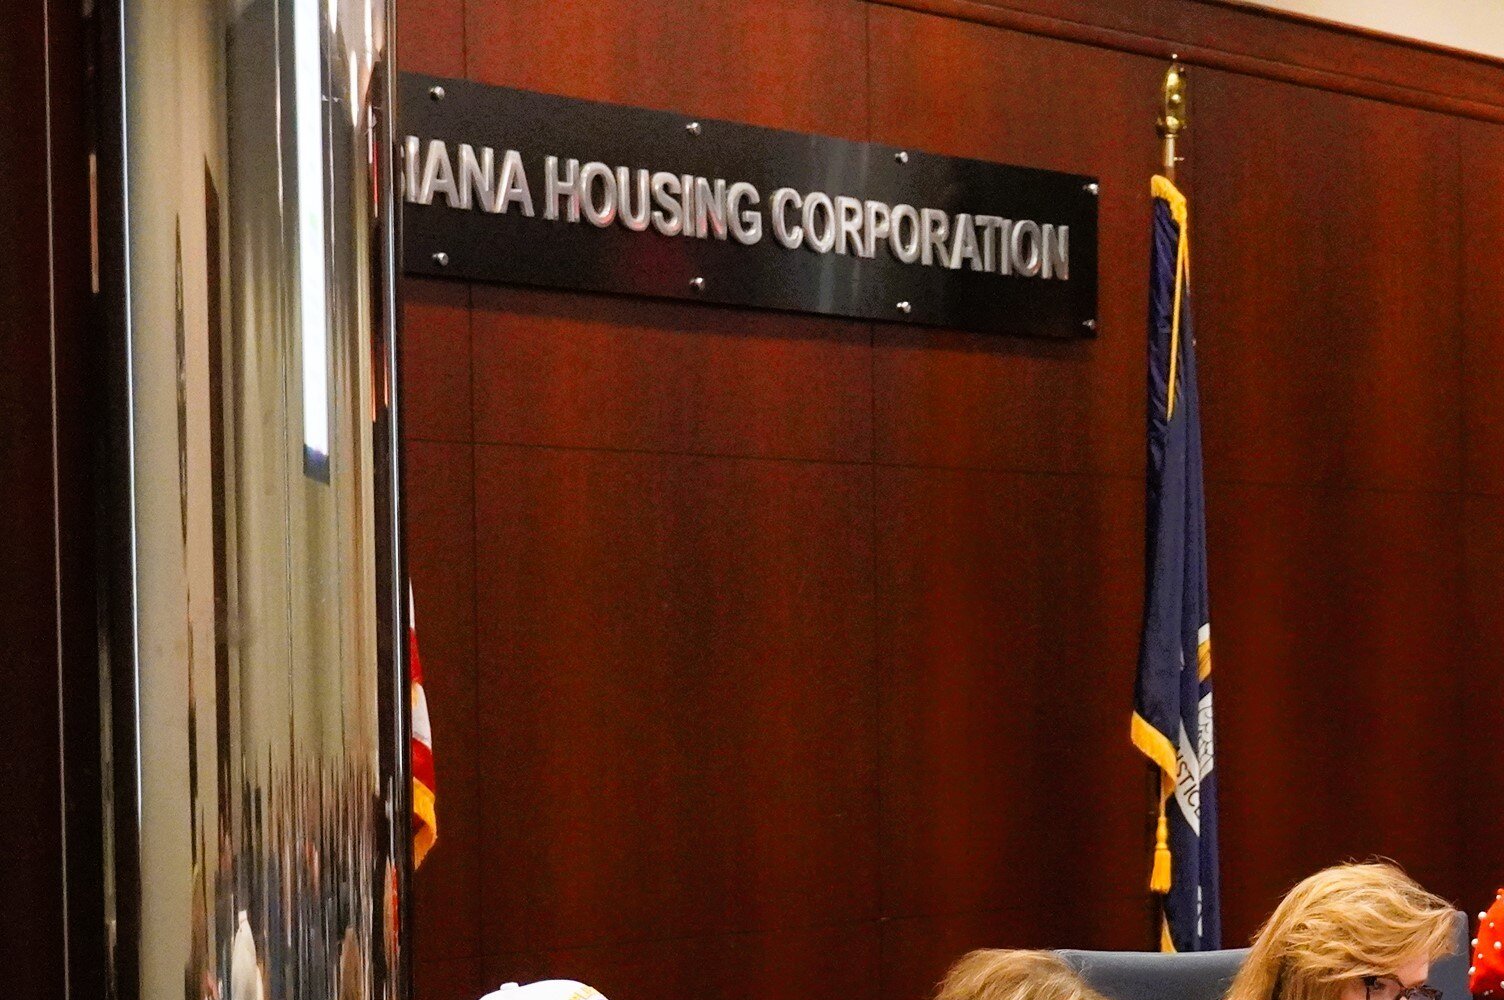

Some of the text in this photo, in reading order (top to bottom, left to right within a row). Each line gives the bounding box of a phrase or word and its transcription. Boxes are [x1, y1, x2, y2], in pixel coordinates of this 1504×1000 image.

[400, 135, 1070, 280] IANA HOUSING CORPORATION
